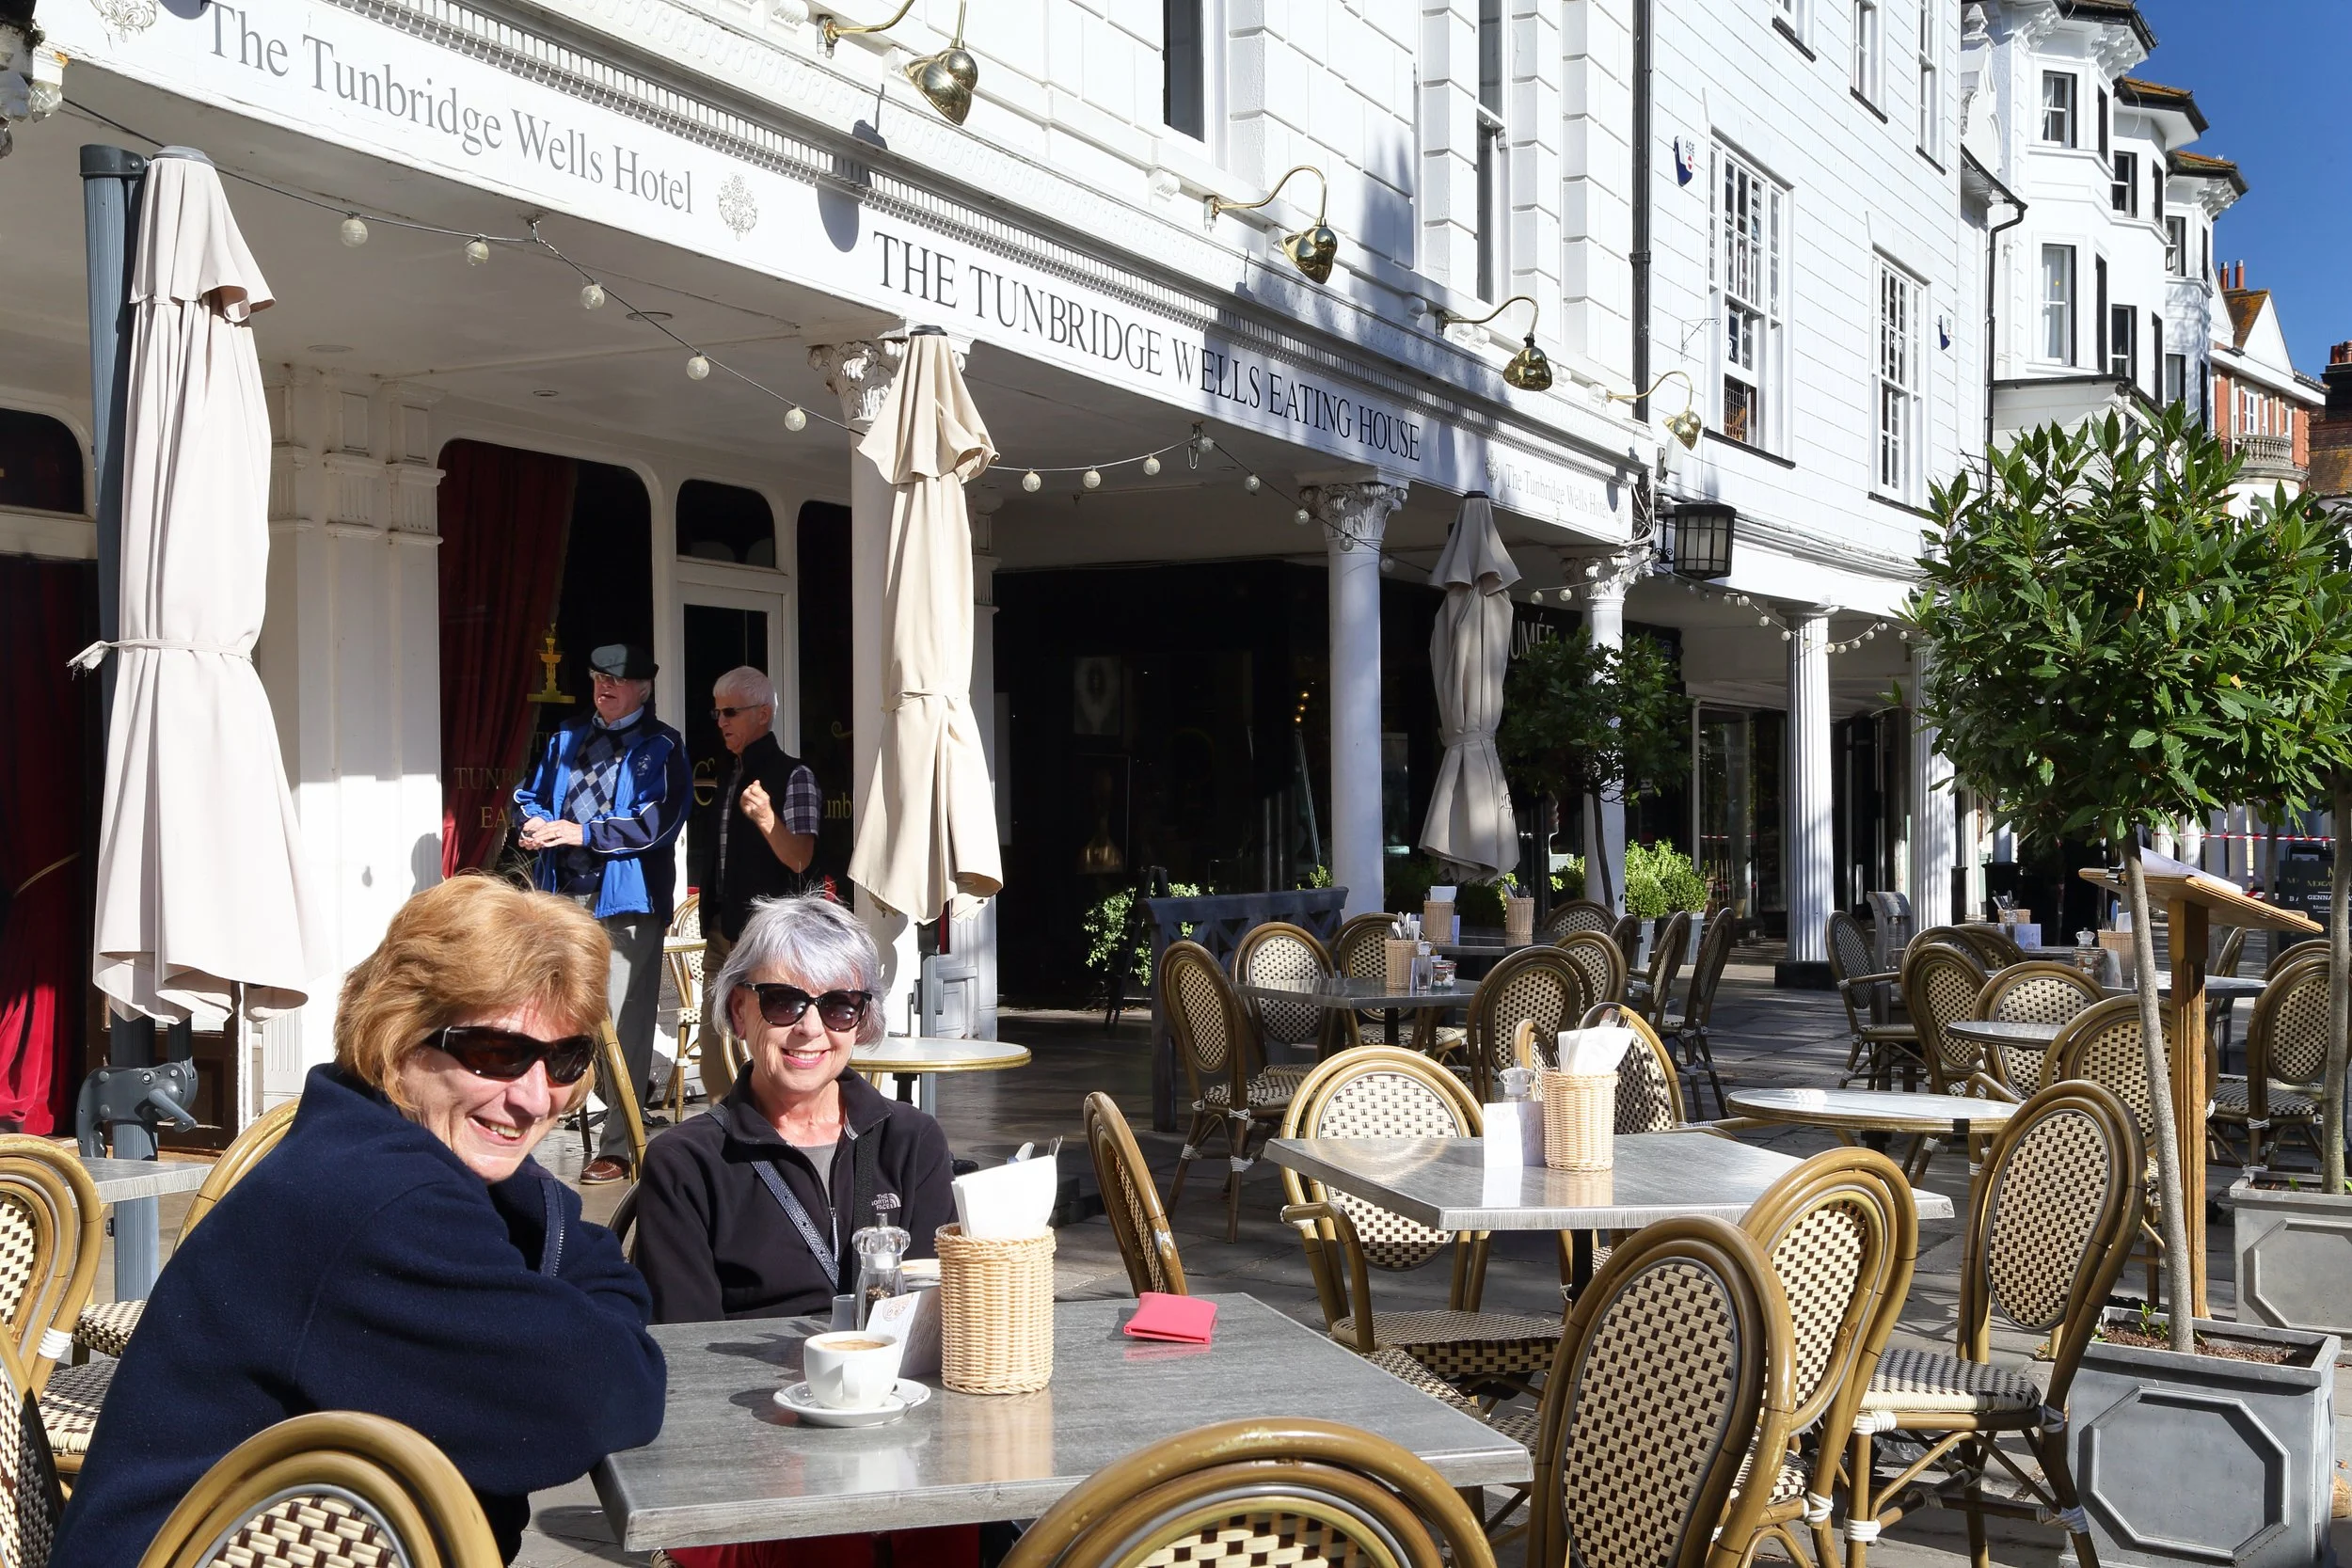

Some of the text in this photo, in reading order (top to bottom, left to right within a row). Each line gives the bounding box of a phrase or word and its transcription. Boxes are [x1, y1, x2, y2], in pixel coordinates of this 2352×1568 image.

[209, 1, 693, 214] The Tunbridge Wells Hotel
[873, 231, 1421, 462] THE TUNBRIDGE WELLS EATING HOUSE
[1505, 464, 1609, 519] The Tunbridge Wells Hotel
